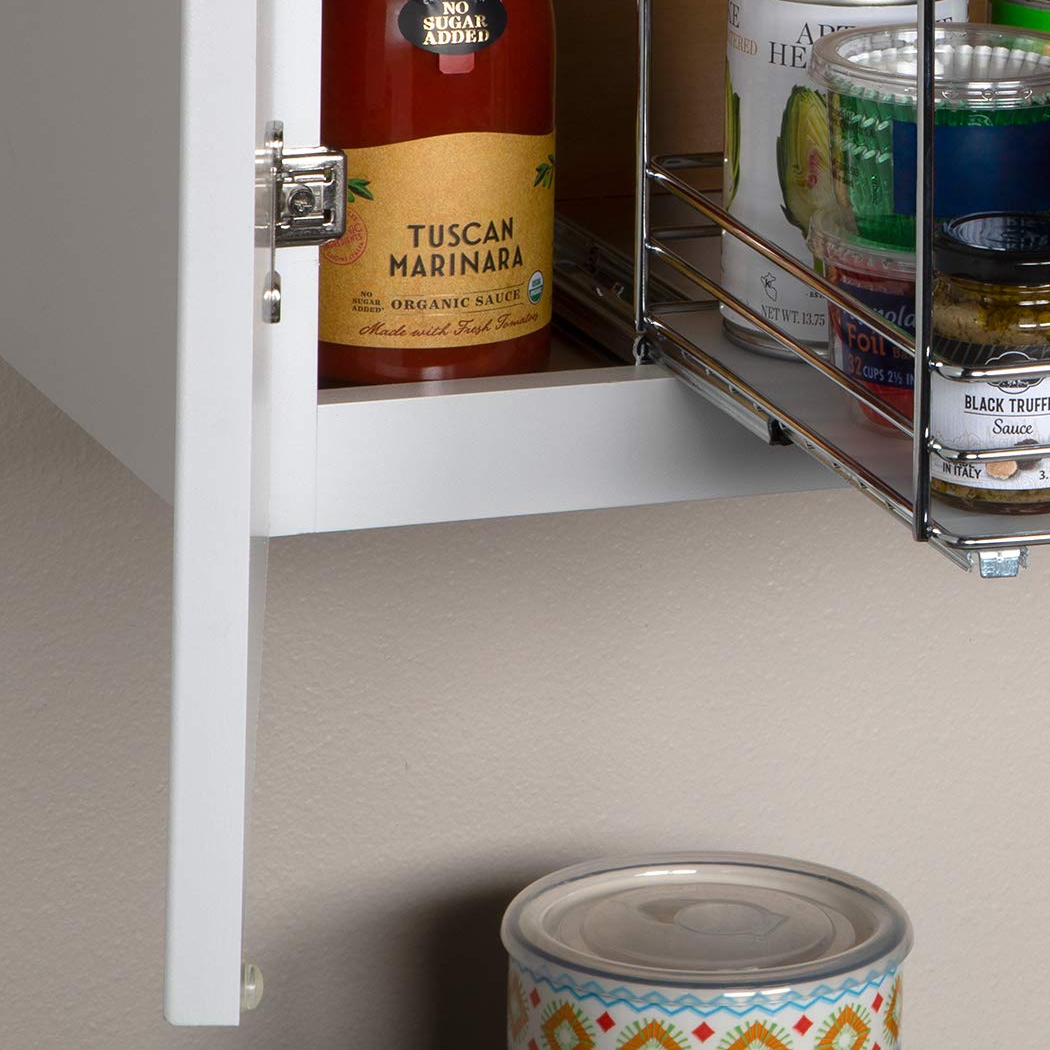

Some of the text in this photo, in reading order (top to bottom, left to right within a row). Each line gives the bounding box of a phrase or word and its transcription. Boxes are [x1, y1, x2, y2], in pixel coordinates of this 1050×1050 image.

[442, 1, 469, 15] NO
[423, 15, 488, 30] SUGAR
[422, 29, 490, 45] ADDED
[407, 217, 513, 248] TUSCAN
[390, 245, 523, 277] MARINARA
[352, 298, 380, 306] SUGAR
[391, 295, 470, 311] ORGANIC
[475, 288, 520, 307] SAUCE
[761, 304, 825, 327] NET WT. 13.75
[359, 312, 539, 337] Made with Fresh Tomatoes
[846, 322, 886, 357] Foil
[863, 365, 884, 381] CUPS
[965, 394, 1004, 412] BLACK
[993, 418, 1033, 435] Sauce
[942, 462, 952, 473] IN
[954, 466, 982, 479] ITALY
